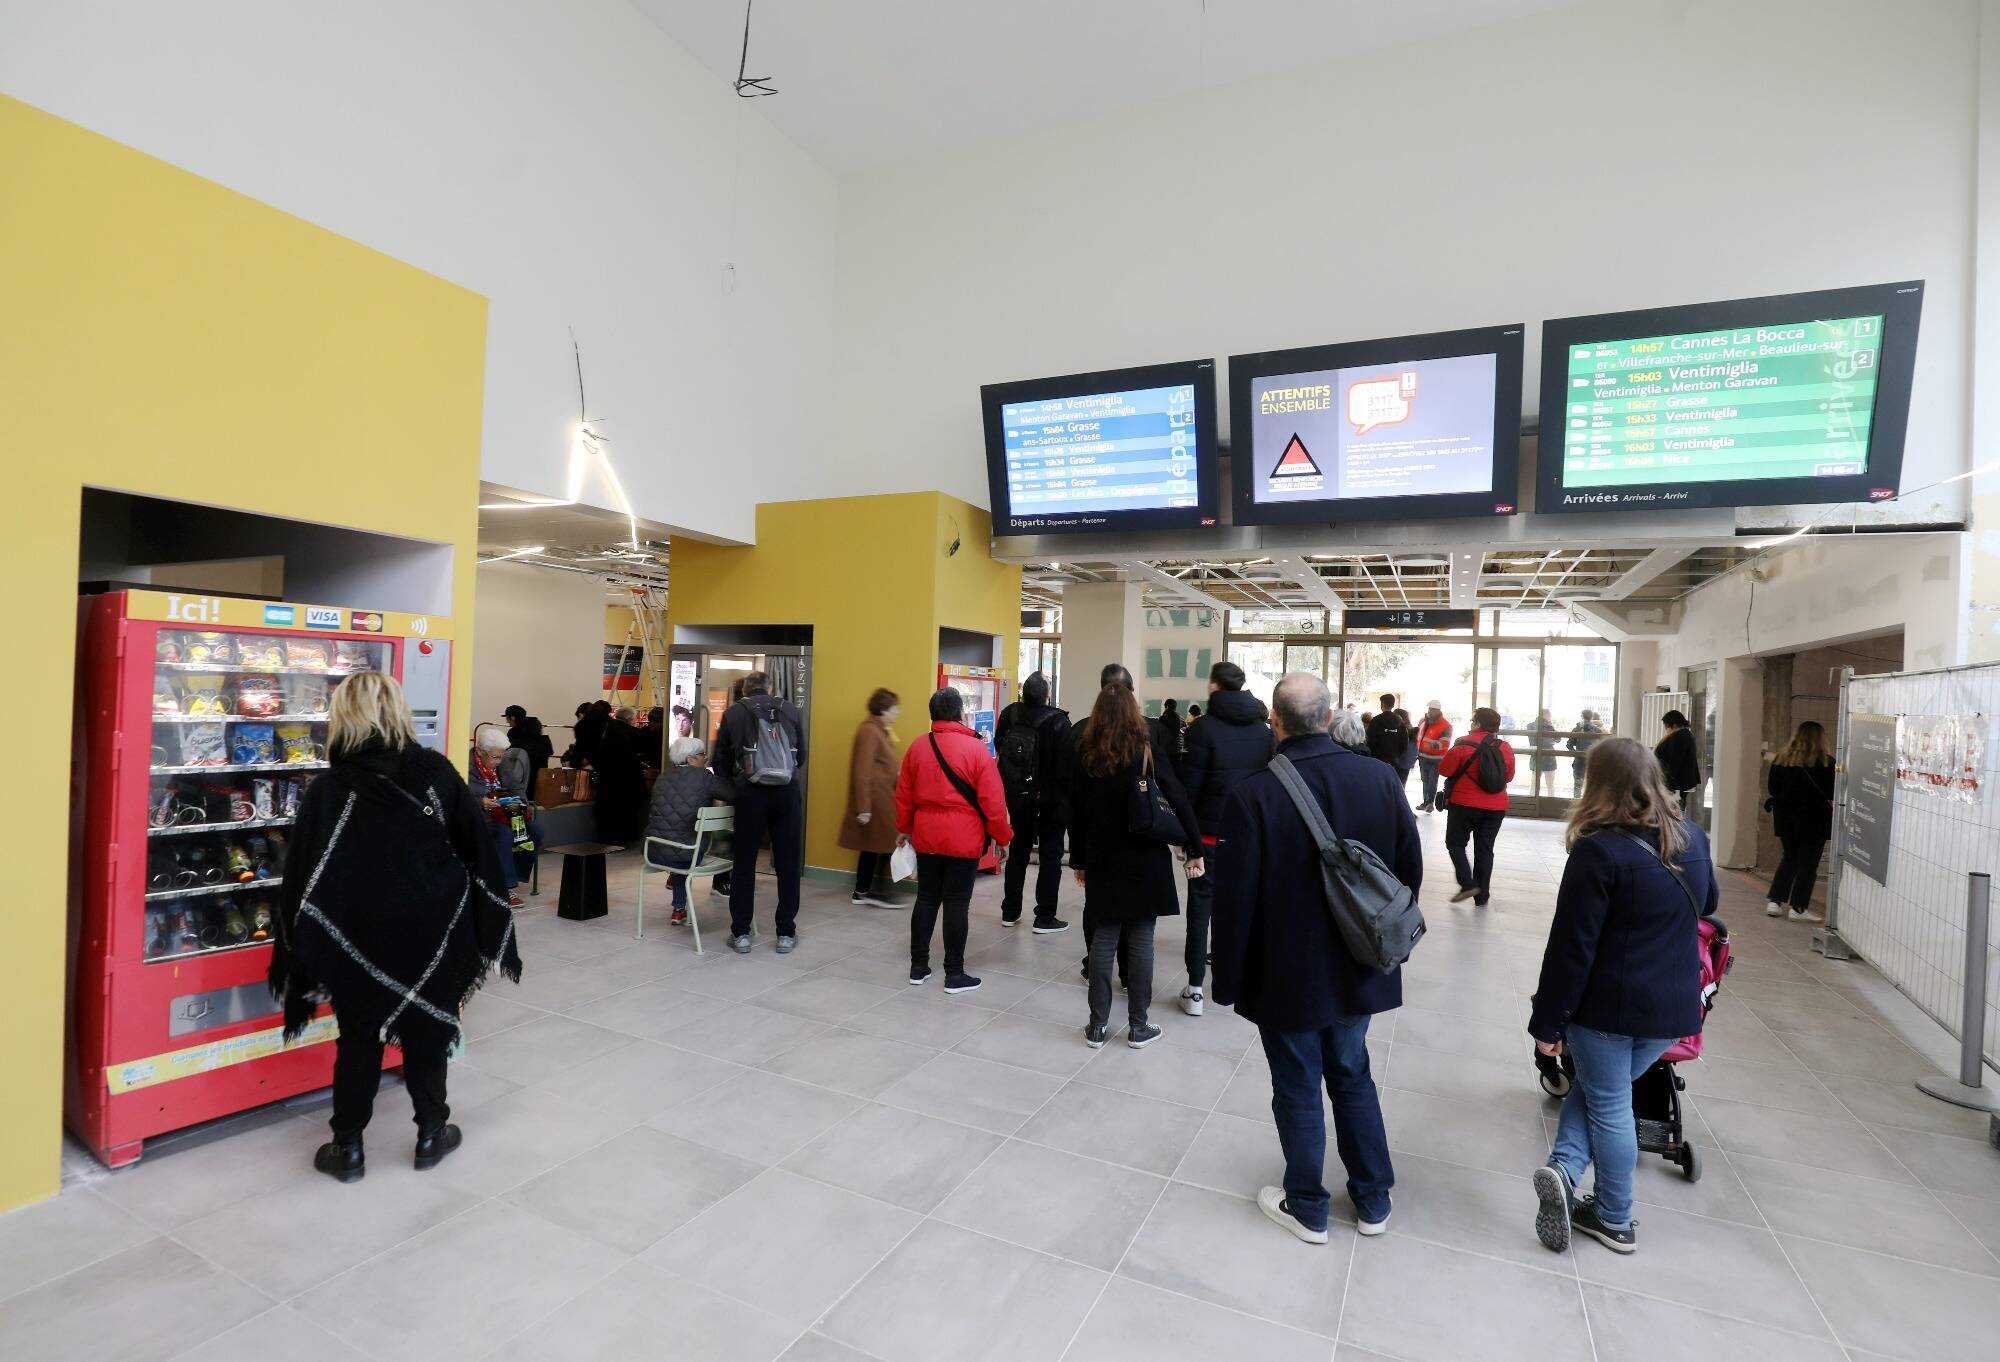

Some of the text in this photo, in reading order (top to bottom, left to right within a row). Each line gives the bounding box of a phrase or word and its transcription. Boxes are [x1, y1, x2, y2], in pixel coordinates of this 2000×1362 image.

[1630, 328, 1805, 354] 14h57 Cannes La Bocca
[1619, 348, 1748, 368] Villefranche-sur-Mer
[1759, 339, 1848, 356] Beaulieu-sur-
[1859, 353, 1868, 364] 2
[1628, 361, 1759, 383] 15h03 Ventimiglia
[1261, 385, 1331, 402] ATTENTIFS
[1594, 376, 1778, 399] Ventimiglia Menton Garavan
[1066, 395, 1123, 409] Ventimiglia
[1261, 398, 1331, 415] ENSEMBLE
[1666, 397, 1708, 407] Grasse
[1626, 408, 1739, 424] 15h33 Ventimiglia
[1067, 422, 1101, 432] Grasse
[1664, 425, 1711, 436] Cannes
[1074, 433, 1101, 442] Grasse
[1663, 437, 1736, 450] Ventimiglia
[1070, 456, 1097, 466] Grasse
[1662, 454, 1692, 464] Nice
[1071, 479, 1098, 488] Grasse
[1563, 491, 1688, 505] Arrivées Arrivals Arrivi
[1010, 519, 1045, 528] Départs
[167, 595, 221, 624] Ici!
[311, 611, 338, 622] VISA
